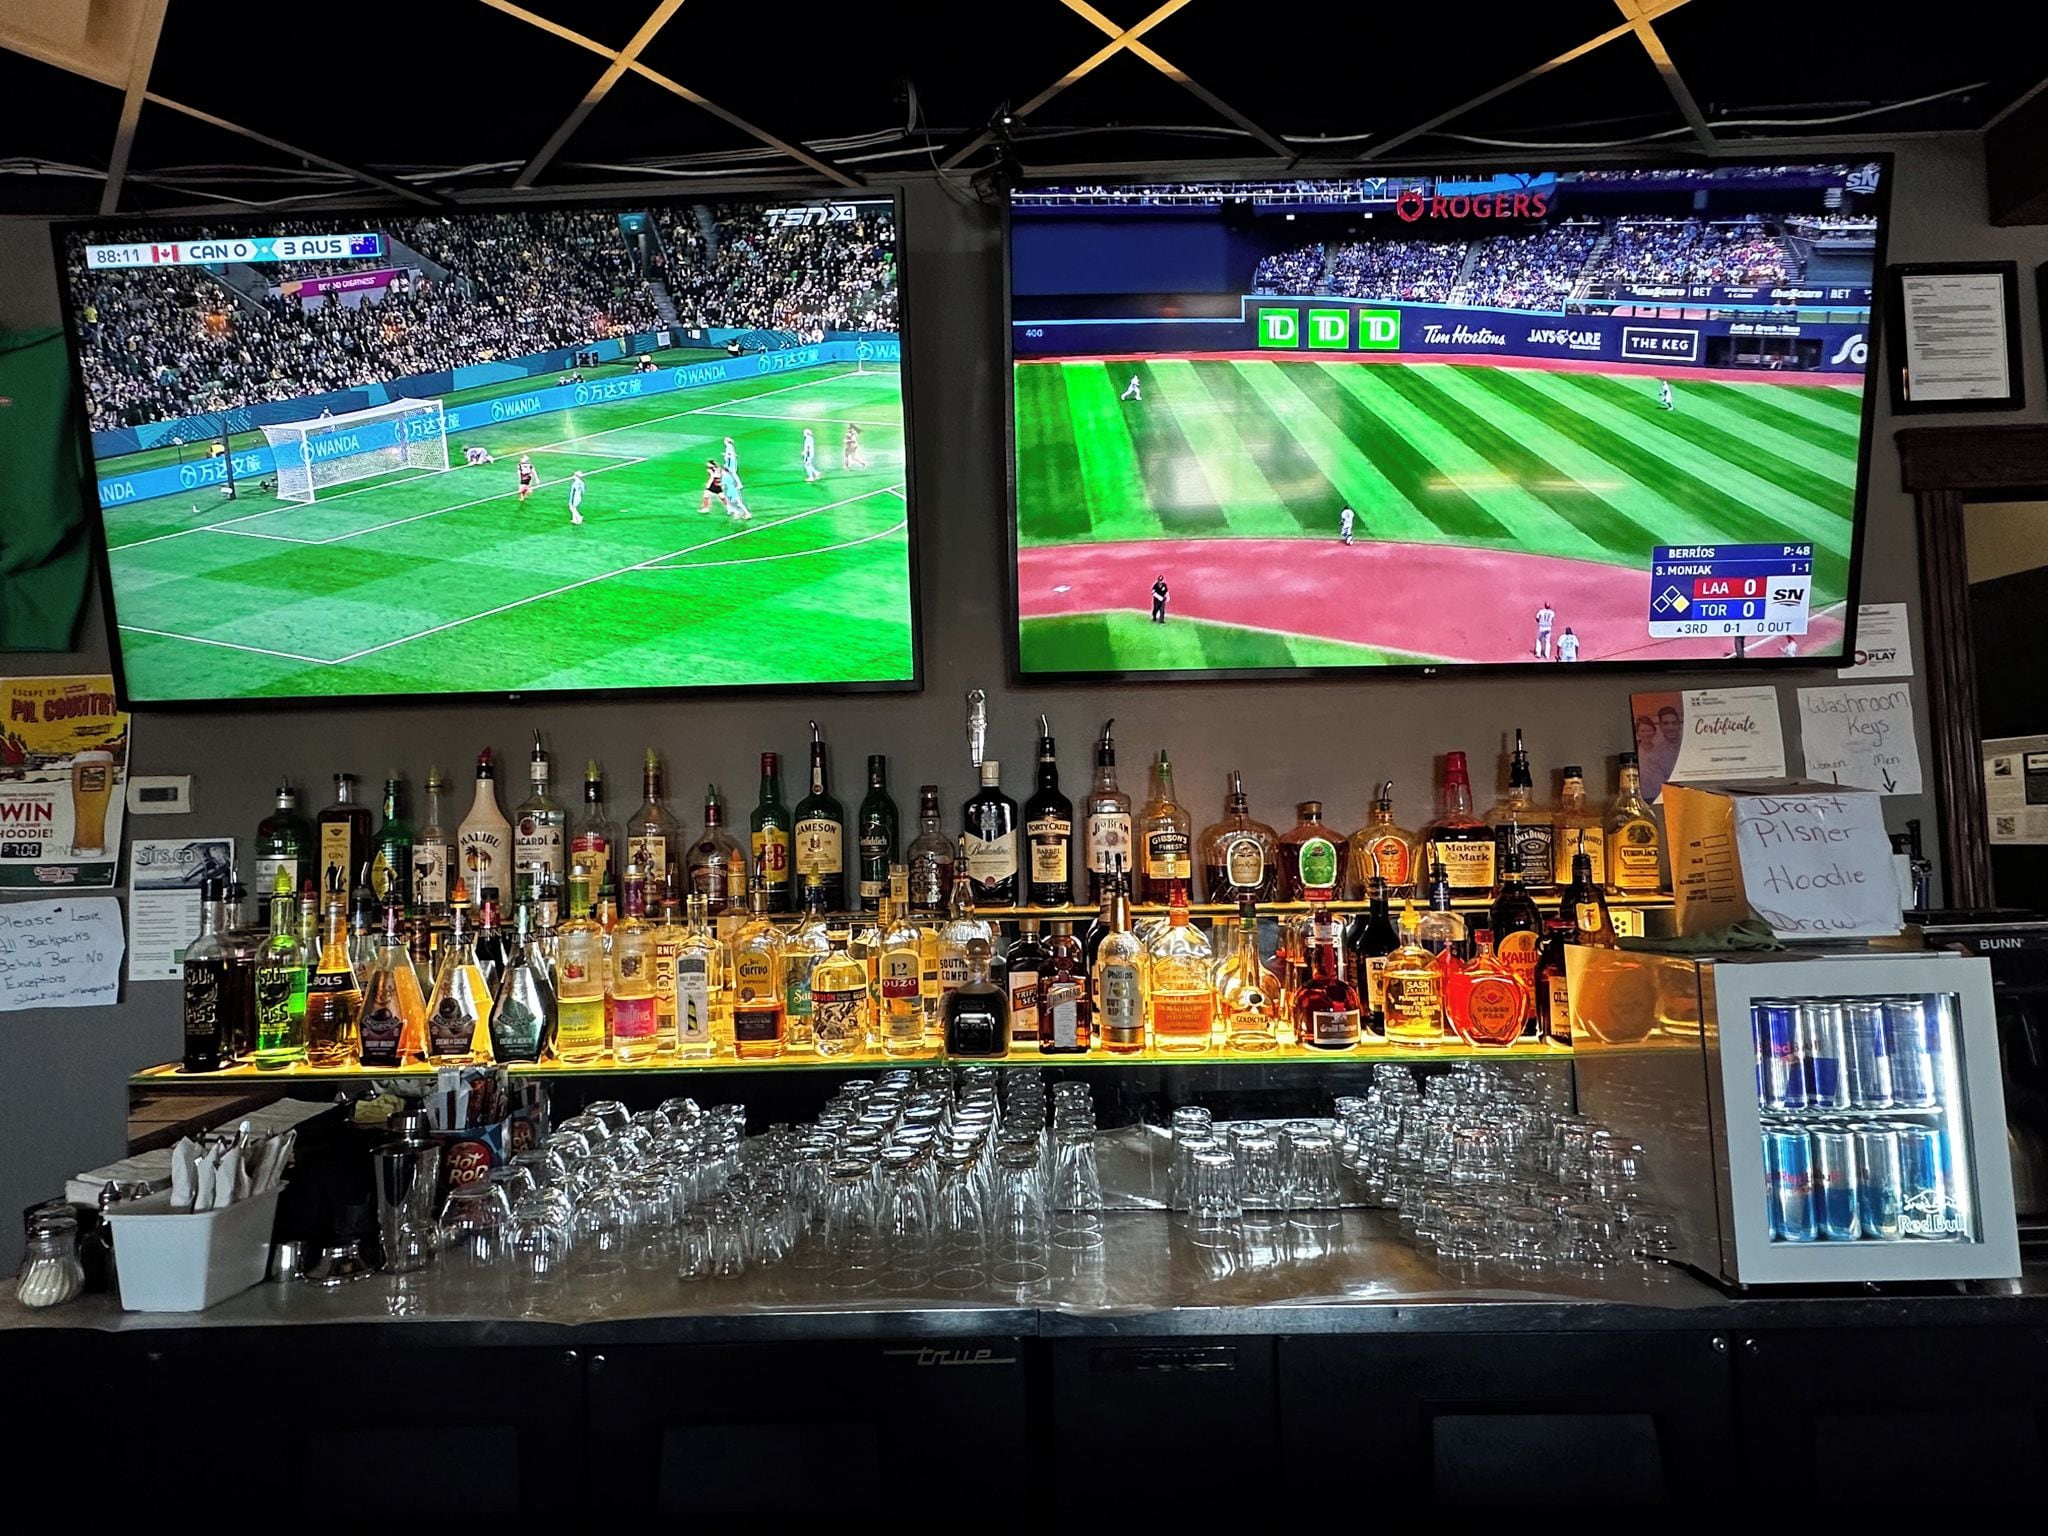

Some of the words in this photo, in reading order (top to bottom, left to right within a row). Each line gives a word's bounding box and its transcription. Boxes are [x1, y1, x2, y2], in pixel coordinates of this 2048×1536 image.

[1432, 193, 1547, 218] ROGERS
[765, 208, 826, 227] TSN
[96, 248, 141, 264] 88:11
[190, 244, 230, 259] CAN
[234, 243, 247, 257] 0
[283, 241, 297, 256] 3
[302, 239, 343, 254] AUS
[1693, 288, 1712, 297] BET
[1830, 289, 1851, 299] BET
[1263, 315, 1294, 340] TD
[1313, 315, 1345, 340] TD
[1363, 315, 1396, 341] TD
[1424, 324, 1450, 344] Tim
[1451, 324, 1505, 346] Hortons
[1527, 329, 1555, 344] JAYS
[1569, 330, 1601, 345] CARE
[1631, 337, 1658, 350] THE
[1662, 338, 1689, 352] KEG
[687, 366, 726, 384] WANDA
[504, 397, 541, 416] WANDA
[315, 435, 360, 458] WANDA
[100, 480, 137, 503] NDA
[1668, 546, 1715, 559] BERRÍOS
[1667, 565, 1712, 576] MONIAK
[1702, 582, 1730, 595] LAA
[1744, 579, 1757, 595] 0
[1773, 588, 1805, 601] SN
[1700, 604, 1727, 617] TOR
[1742, 602, 1755, 617] 0
[1684, 623, 1708, 634] 3RD
[1723, 623, 1740, 633] 0-1
[1757, 624, 1764, 633] 0
[1767, 622, 1792, 632] OUT
[1868, 652, 1896, 660] PLAY
[1807, 690, 1910, 715] Washroom
[11, 699, 39, 723] PIL
[1695, 716, 1755, 735] Certificate
[1847, 715, 1890, 747] Keys
[1873, 752, 1901, 769] Men
[0, 802, 52, 821] WIN
[797, 823, 836, 835] JAMESON
[1028, 823, 1048, 831] FORTY
[1048, 822, 1070, 831] CREEK
[1092, 821, 1107, 837] JIM
[1107, 818, 1129, 836] BEAM
[1740, 817, 1860, 848] Pilsner
[460, 832, 502, 849] MALIBU
[1151, 834, 1188, 845] GIBSON'S
[1515, 831, 1529, 845] JACK
[1444, 843, 1490, 852] Maker's
[1458, 853, 1490, 862] Mark
[1764, 864, 1867, 894] Hoodie
[1762, 908, 1858, 933] Draw
[1979, 938, 2022, 950] BUNN
[740, 964, 768, 977] Cuervo
[890, 962, 908, 977] 12
[314, 975, 343, 986] BOLS
[883, 979, 917, 988] OUZO
[1406, 981, 1430, 989] SASK
[1898, 1213, 1933, 1234] Red
